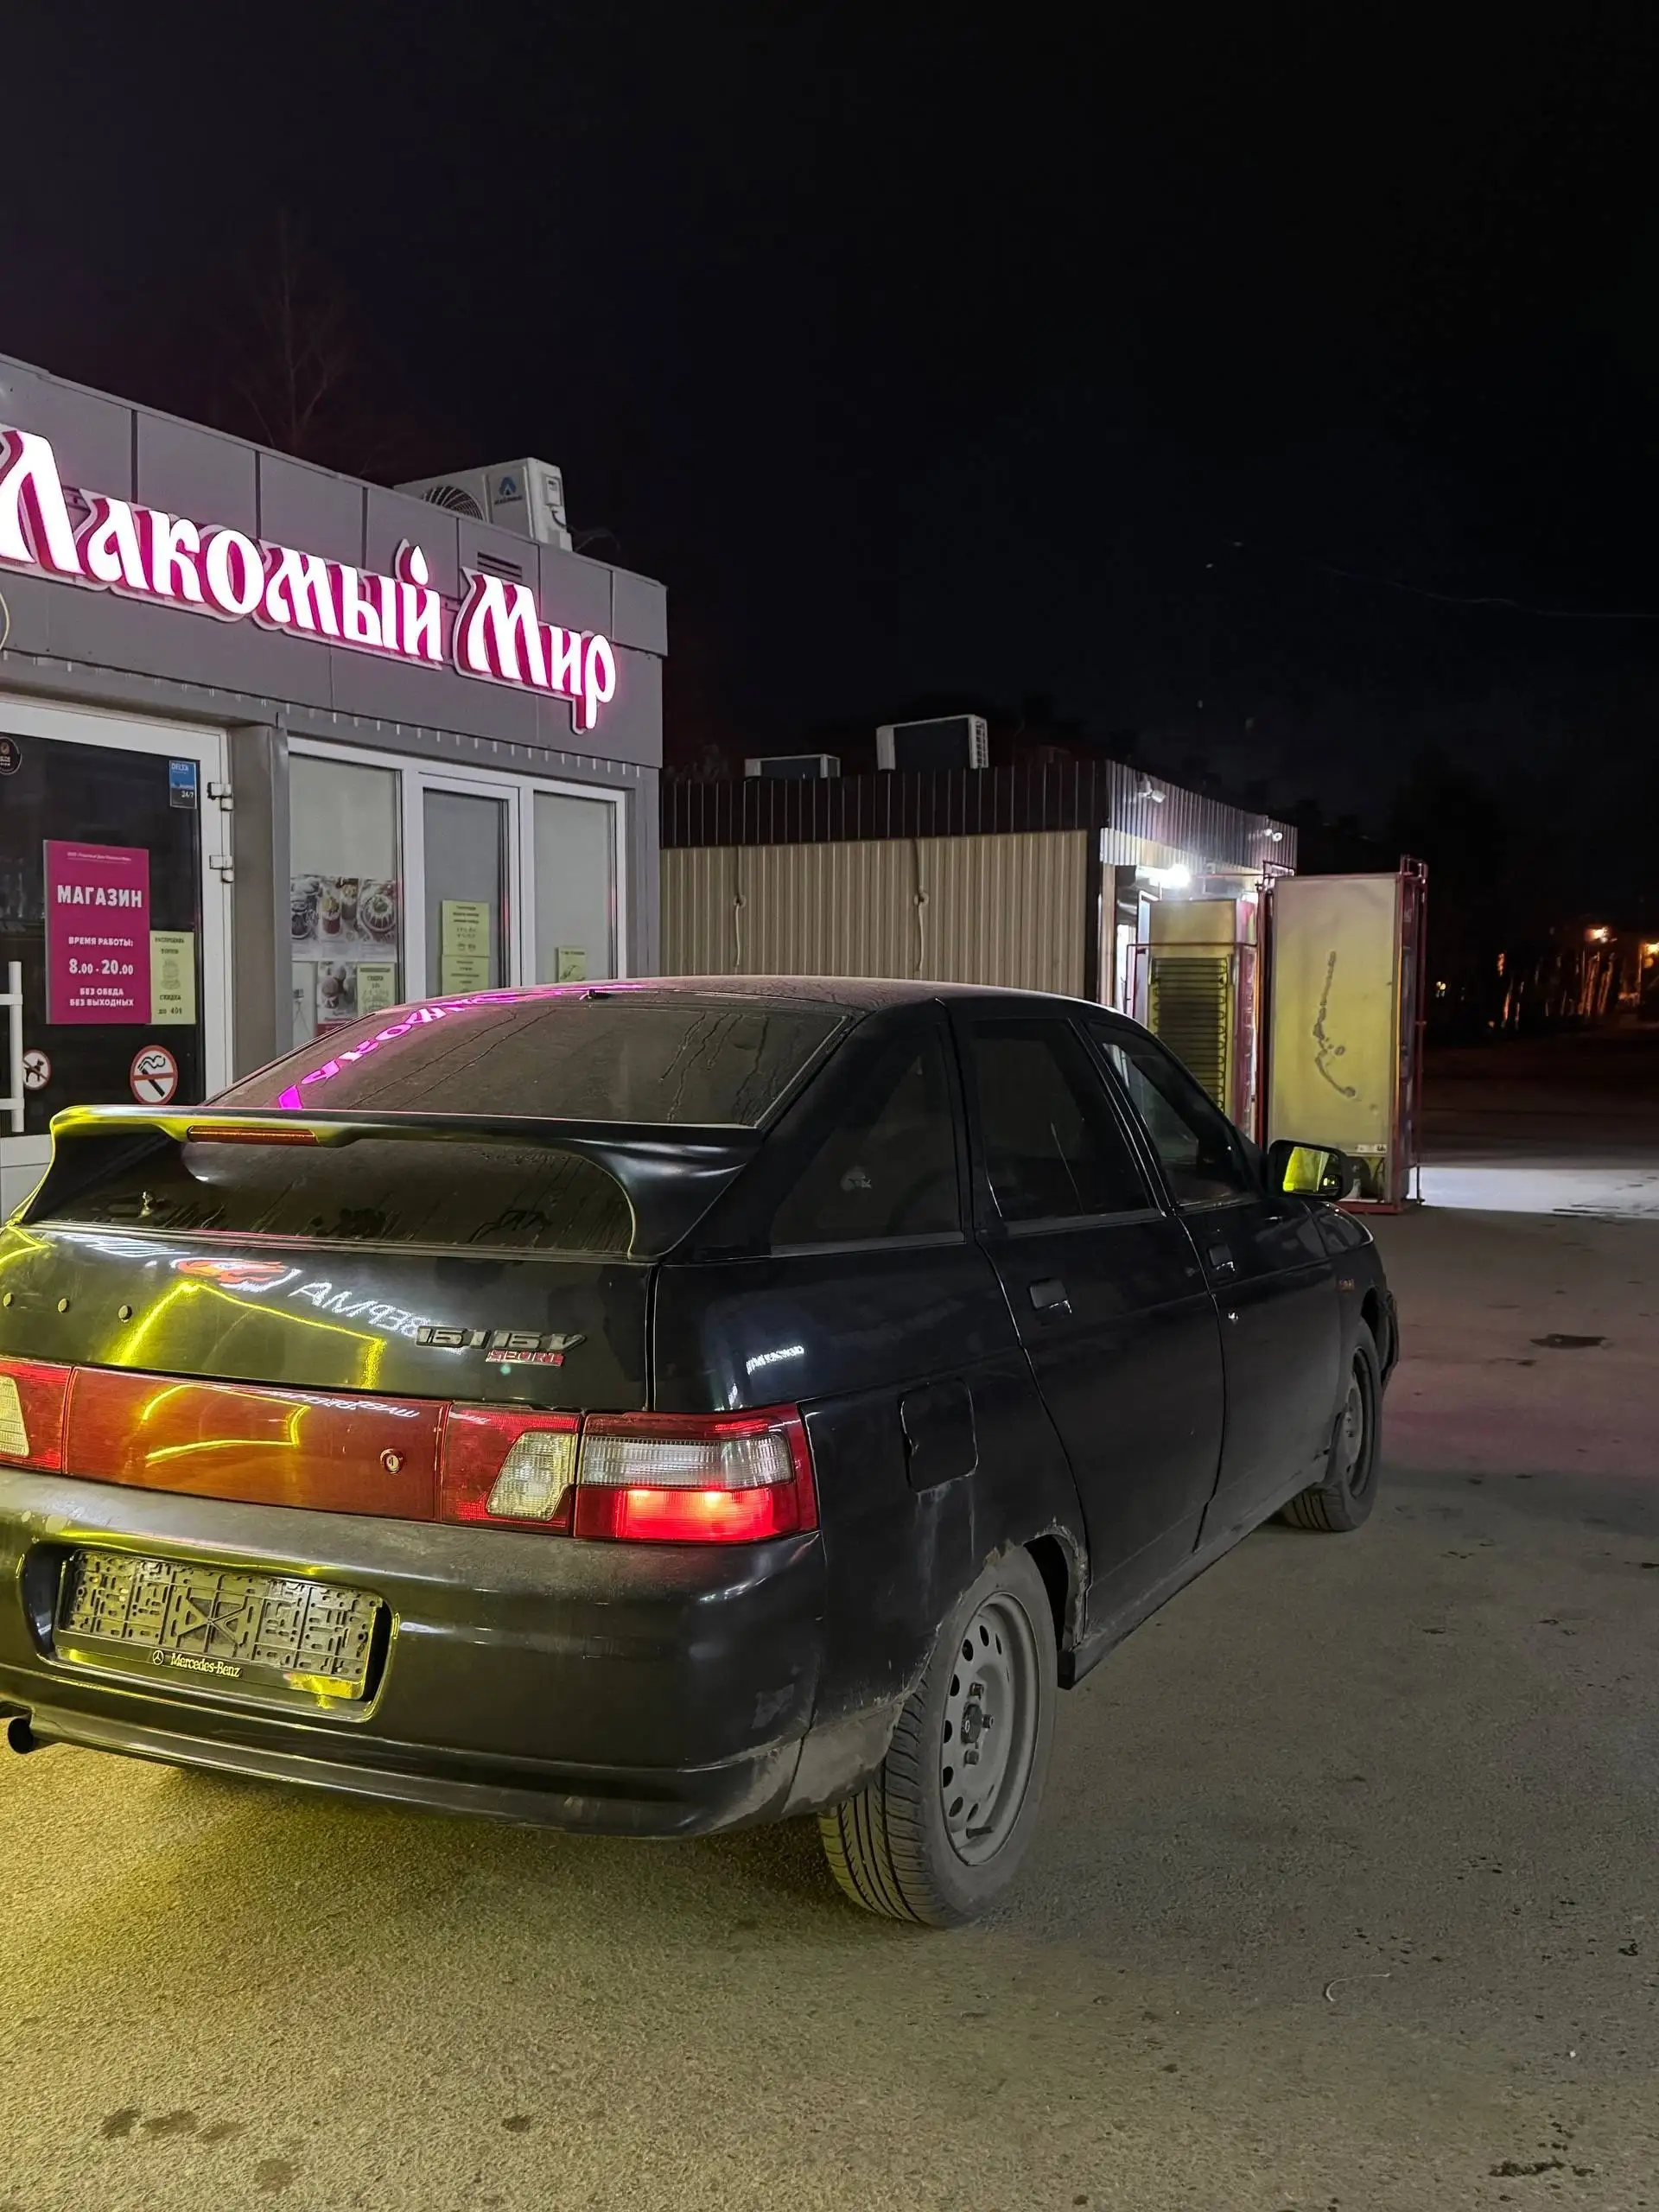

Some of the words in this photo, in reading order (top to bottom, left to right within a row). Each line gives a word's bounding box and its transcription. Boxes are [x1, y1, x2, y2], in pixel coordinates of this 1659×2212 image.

[0, 429, 444, 664] Лакомый
[457, 572, 616, 731] Мир
[57, 884, 143, 908] МАГАЗИН
[68, 936, 97, 945] ВРЕМЯ
[98, 938, 134, 947] РАБОТЫ:
[69, 957, 93, 975] 8.00
[101, 959, 134, 976] 20.00
[96, 988, 124, 996] ОБЕДА
[69, 998, 86, 1007] БЕЗ
[86, 999, 135, 1007] ВЫХОДНЫХ
[170, 1652, 242, 1678] Mercedes-Benz
